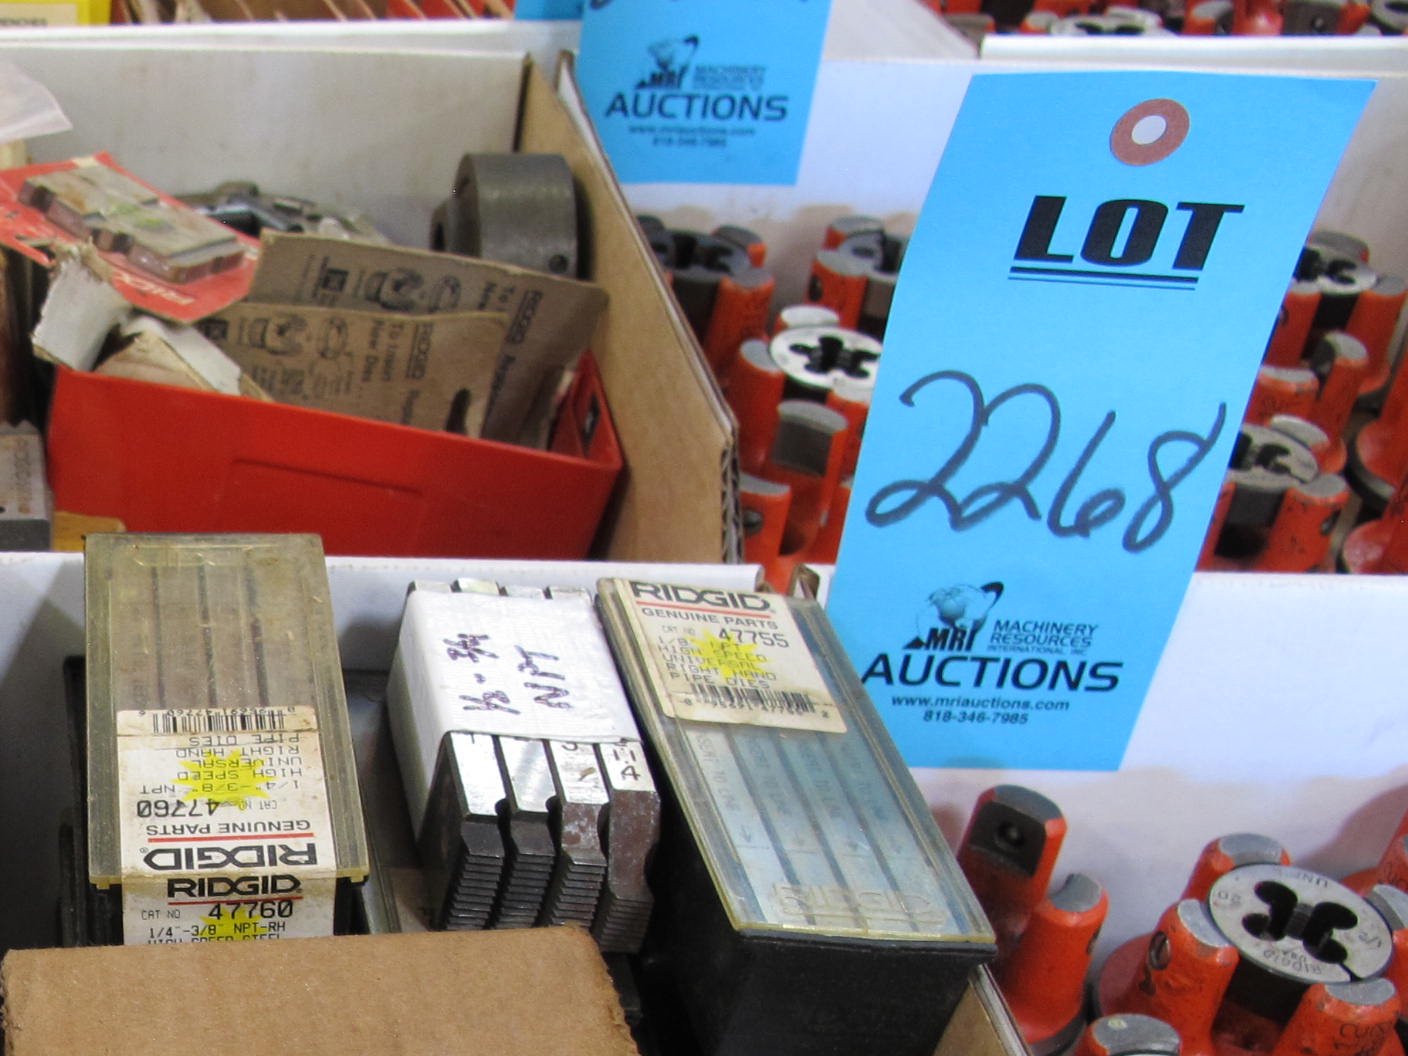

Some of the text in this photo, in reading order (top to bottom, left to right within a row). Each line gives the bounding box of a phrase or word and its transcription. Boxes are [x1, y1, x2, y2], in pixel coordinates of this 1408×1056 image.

[605, 92, 789, 122] AUCTIONS
[1013, 194, 1245, 271] LOT
[865, 369, 1227, 554] 2268
[628, 581, 771, 613] RIDGID
[641, 607, 780, 631] GENUINE PARTS
[993, 618, 1100, 637] MACHINERY
[718, 628, 791, 648] 47755
[924, 626, 979, 652] MRI
[990, 632, 1093, 649] RESOURCES
[657, 645, 769, 664] HIGH SPEED
[662, 653, 764, 672] UNIVERSAL
[665, 662, 778, 682] RIGHT HAND
[669, 672, 771, 690] PIPE DIES
[860, 652, 1124, 692] AUCTIONS
[890, 694, 1071, 712] www.mriauctions.com
[922, 708, 1030, 725] 818-346-7985
[188, 734, 300, 747] PIPE DIES
[176, 746, 300, 759] RIGHT HAND
[193, 757, 303, 770] UNIVERSAL
[177, 768, 303, 782] HIGH SPEED
[139, 783, 176, 795] NPT
[136, 799, 222, 819] 47760
[146, 819, 312, 836] GENUINE PARTS
[143, 842, 318, 872] RIDGID
[167, 874, 304, 899] RIDGID
[141, 908, 182, 921] CAT NO
[207, 899, 295, 921] 47760
[233, 920, 287, 935] NPT-RH
